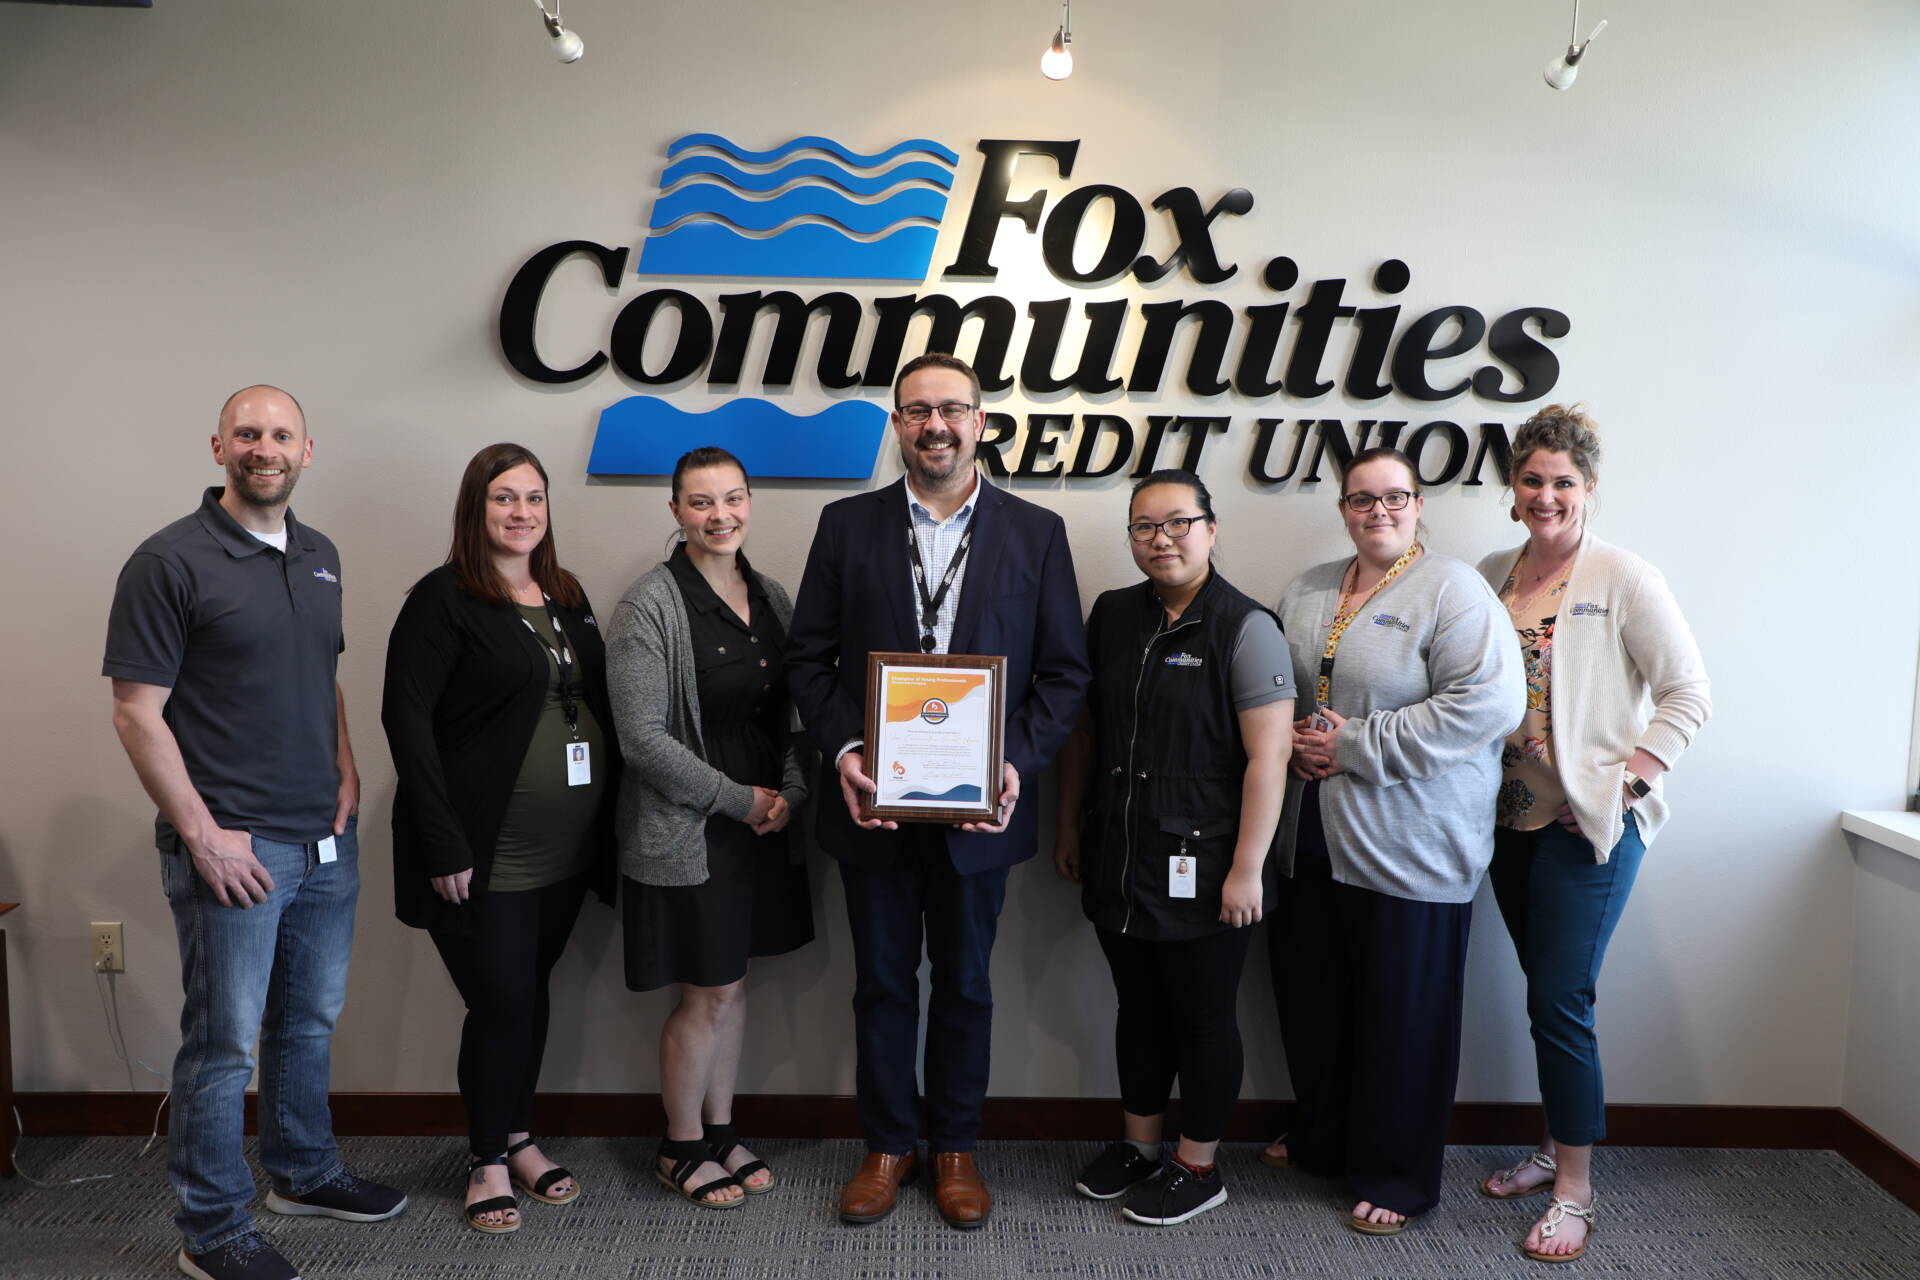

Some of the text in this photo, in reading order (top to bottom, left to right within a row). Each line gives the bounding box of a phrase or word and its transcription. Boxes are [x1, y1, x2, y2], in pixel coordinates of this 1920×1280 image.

[943, 138, 1254, 285] Fox
[499, 240, 1571, 403] Communities
[974, 412, 1232, 479] REDIT
